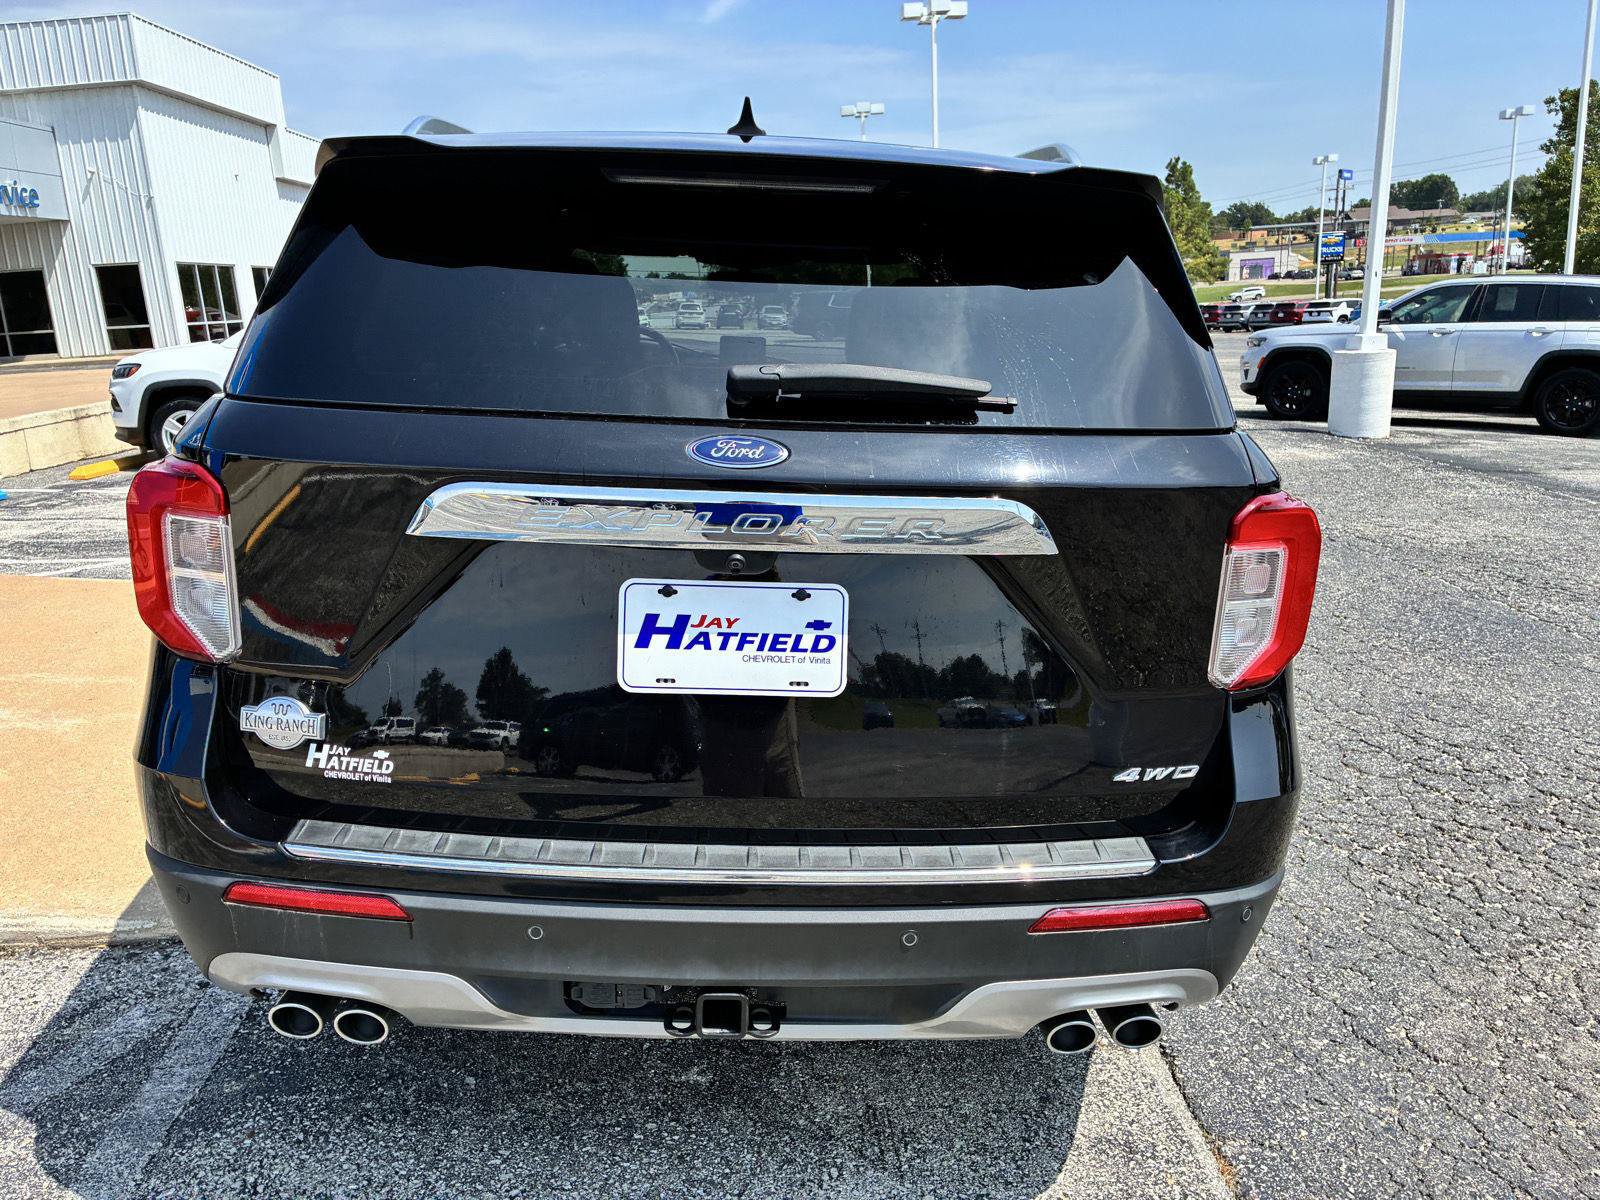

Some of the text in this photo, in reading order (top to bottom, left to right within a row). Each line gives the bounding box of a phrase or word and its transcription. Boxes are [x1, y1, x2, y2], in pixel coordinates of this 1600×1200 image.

[711, 439, 765, 459] Ford
[515, 504, 945, 539] EXPLORER
[690, 614, 741, 629] JAY
[633, 613, 837, 654] HATFIELD
[742, 654, 831, 665] CHEVROLET of Vinita
[245, 712, 316, 735] KING RANCH
[305, 743, 394, 774] HATFIELD
[328, 744, 352, 756] JAY
[324, 770, 392, 784] CHEVROLET of Vinita
[1112, 765, 1200, 782] 4WD
